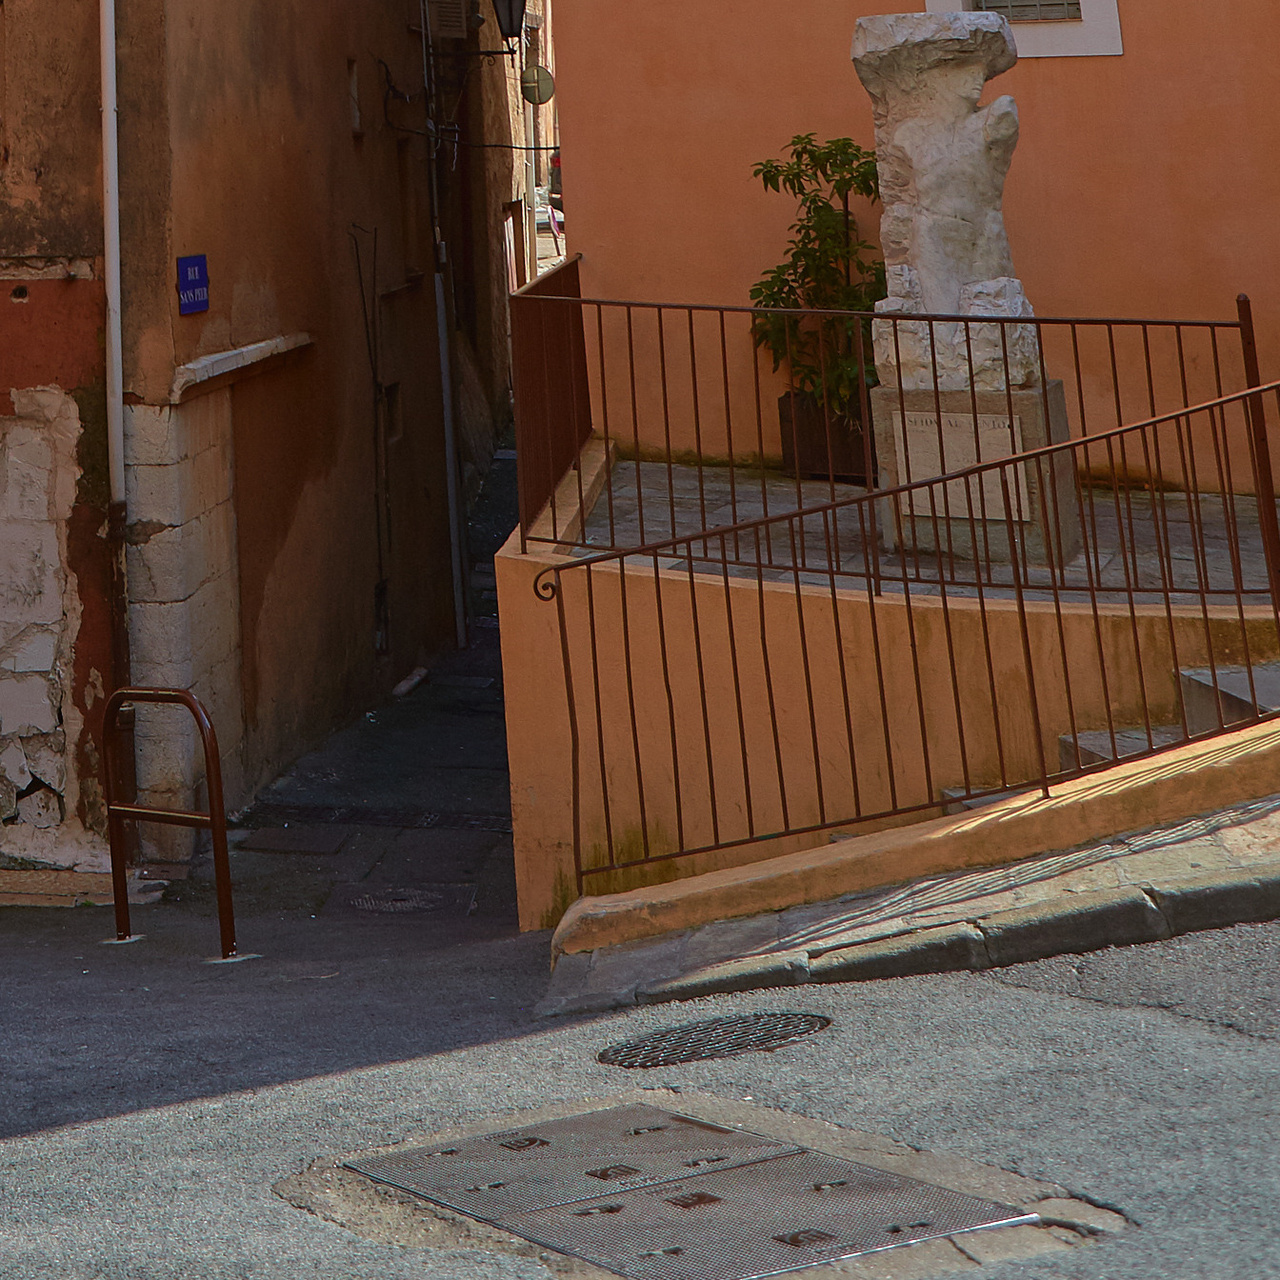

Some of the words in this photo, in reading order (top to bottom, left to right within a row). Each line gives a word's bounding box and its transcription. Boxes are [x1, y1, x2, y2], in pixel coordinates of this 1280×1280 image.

[187, 266, 199, 280] RUE
[180, 290, 194, 304] SANS
[194, 287, 207, 301] PEUR
